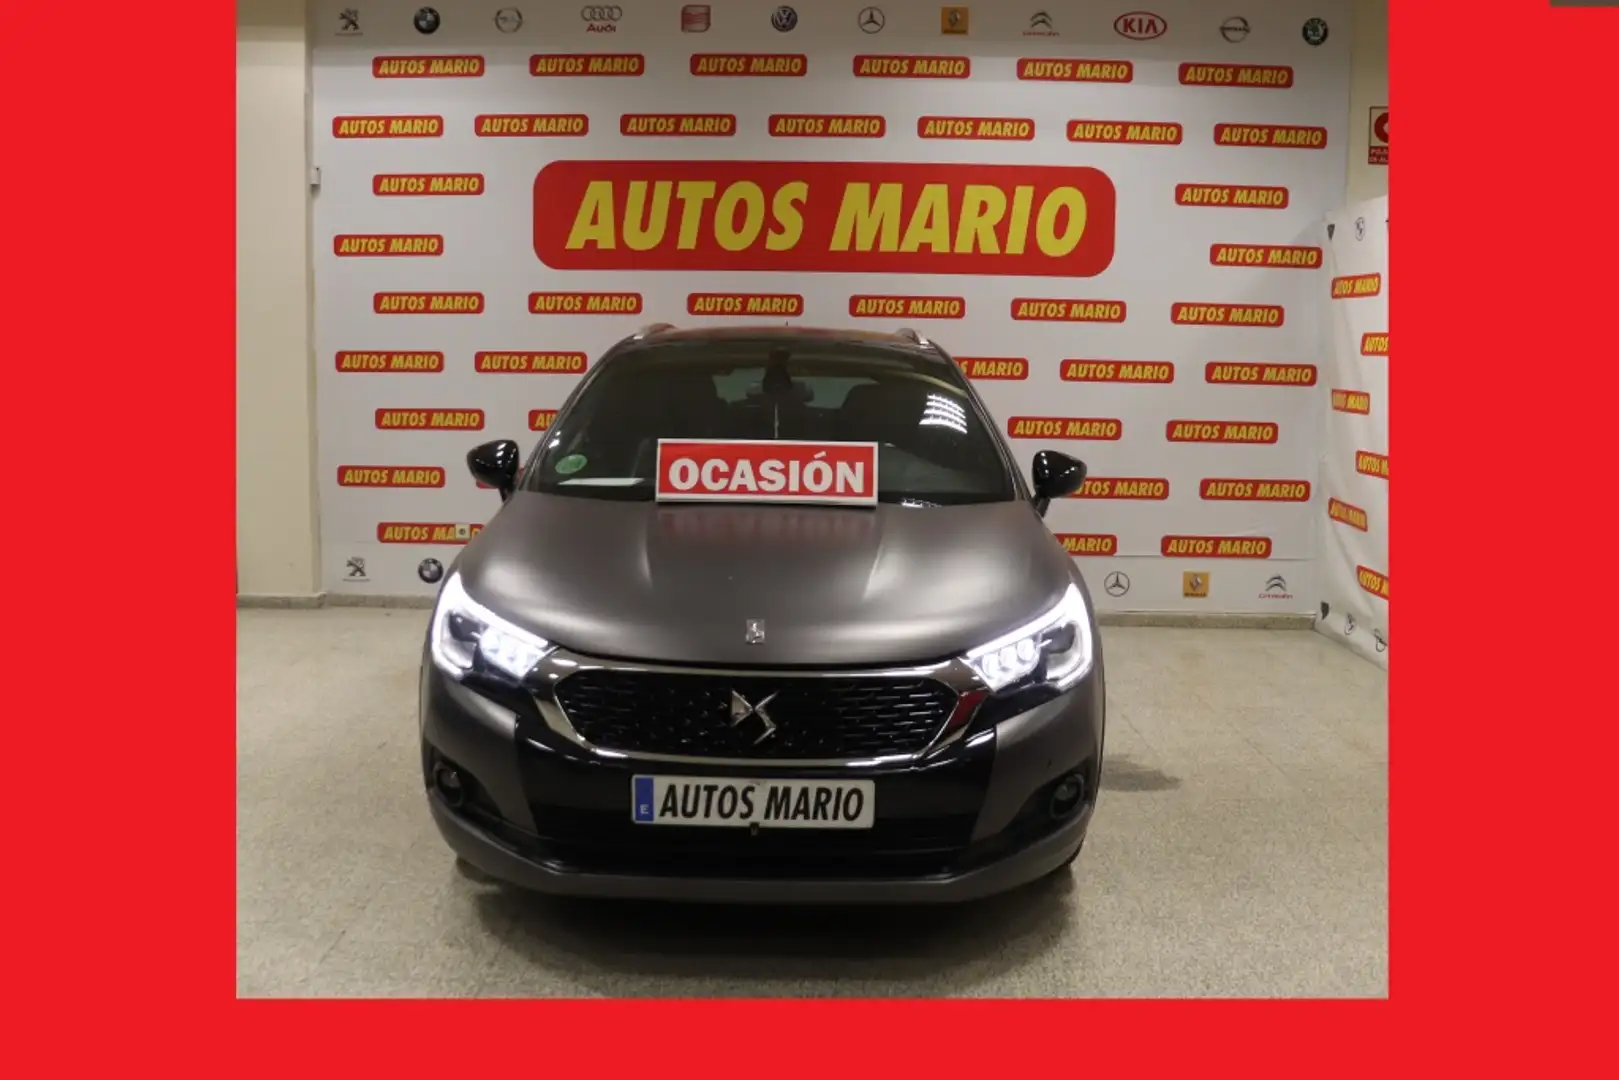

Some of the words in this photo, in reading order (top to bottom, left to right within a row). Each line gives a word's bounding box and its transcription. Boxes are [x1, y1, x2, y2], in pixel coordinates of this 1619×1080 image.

[1123, 17, 1158, 34] KIA
[380, 60, 427, 75] AUTOS
[430, 59, 480, 74] MARIO
[538, 58, 585, 74] AUTOS
[589, 58, 639, 73] MARIO
[699, 57, 747, 73] AUTOS
[751, 58, 802, 73] MARIO
[861, 58, 910, 74] AUTOS
[914, 58, 966, 75] MARIO
[1023, 61, 1072, 77] AUTOS
[1076, 63, 1129, 79] MARIO
[1186, 67, 1234, 82] AUTOS
[1237, 68, 1288, 84] MARIO
[339, 119, 385, 136] AUTOS
[389, 118, 438, 134] MARIO
[481, 117, 529, 133] AUTOS
[533, 117, 584, 133] MARIO
[628, 117, 676, 131] AUTOS
[680, 117, 731, 132] MARIO
[775, 118, 824, 133] AUTOS
[828, 118, 881, 134] MARIO
[926, 119, 975, 136] AUTOS
[979, 120, 1031, 137] MARIO
[1073, 124, 1122, 139] AUTOS
[1126, 125, 1178, 141] MARIO
[1221, 127, 1268, 143] AUTOS
[1272, 129, 1323, 145] MARIO
[379, 177, 426, 193] AUTOS
[429, 177, 479, 192] MARIO
[1182, 187, 1230, 203] AUTOS
[1233, 189, 1284, 205] MARIO
[565, 180, 808, 251] AUTOS
[828, 182, 1087, 256] MARIO
[340, 238, 385, 253] AUTOS
[389, 237, 437, 252] MARIO
[1217, 247, 1264, 264] AUTOS
[1267, 248, 1317, 265] MARIO
[379, 295, 426, 310] AUTOS
[429, 295, 479, 311] MARIO
[535, 295, 583, 311] AUTOS
[587, 296, 638, 311] MARIO
[694, 297, 742, 311] AUTOS
[746, 297, 798, 313] MARIO
[857, 299, 905, 314] AUTOS
[909, 300, 960, 315] MARIO
[1019, 302, 1066, 317] AUTOS
[1070, 303, 1121, 319] MARIO
[1179, 306, 1226, 321] AUTOS
[1229, 309, 1279, 323] MARIO
[342, 354, 387, 369] AUTOS
[391, 355, 439, 369] MARIO
[482, 355, 529, 369] AUTOS
[532, 355, 582, 370] MARIO
[971, 360, 1024, 377] MARIO
[1067, 363, 1115, 379] AUTOS
[1119, 365, 1170, 380] MARIO
[1213, 365, 1259, 380] AUTOS
[1263, 367, 1312, 382] MARIO
[382, 412, 428, 426] AUTOS
[431, 412, 480, 427] MARIO
[1014, 421, 1062, 435] AUTOS
[1066, 421, 1117, 436] MARIO
[1173, 423, 1220, 438] AUTOS
[1224, 424, 1274, 440] MARIO
[344, 469, 389, 483] AUTOS
[393, 470, 441, 484] MARIO
[668, 451, 864, 493] OCASIÓN
[1074, 480, 1111, 495] TOS
[1113, 481, 1165, 497] MARIO
[1206, 483, 1253, 497] AUTOS
[1256, 483, 1306, 498] MARIO
[383, 526, 429, 541] AUTOS
[1063, 537, 1113, 553] MARIO
[1169, 538, 1215, 553] AUTOS
[1218, 540, 1267, 555] MARIO
[659, 784, 756, 820] AUTOS
[764, 786, 865, 822] MARIO
